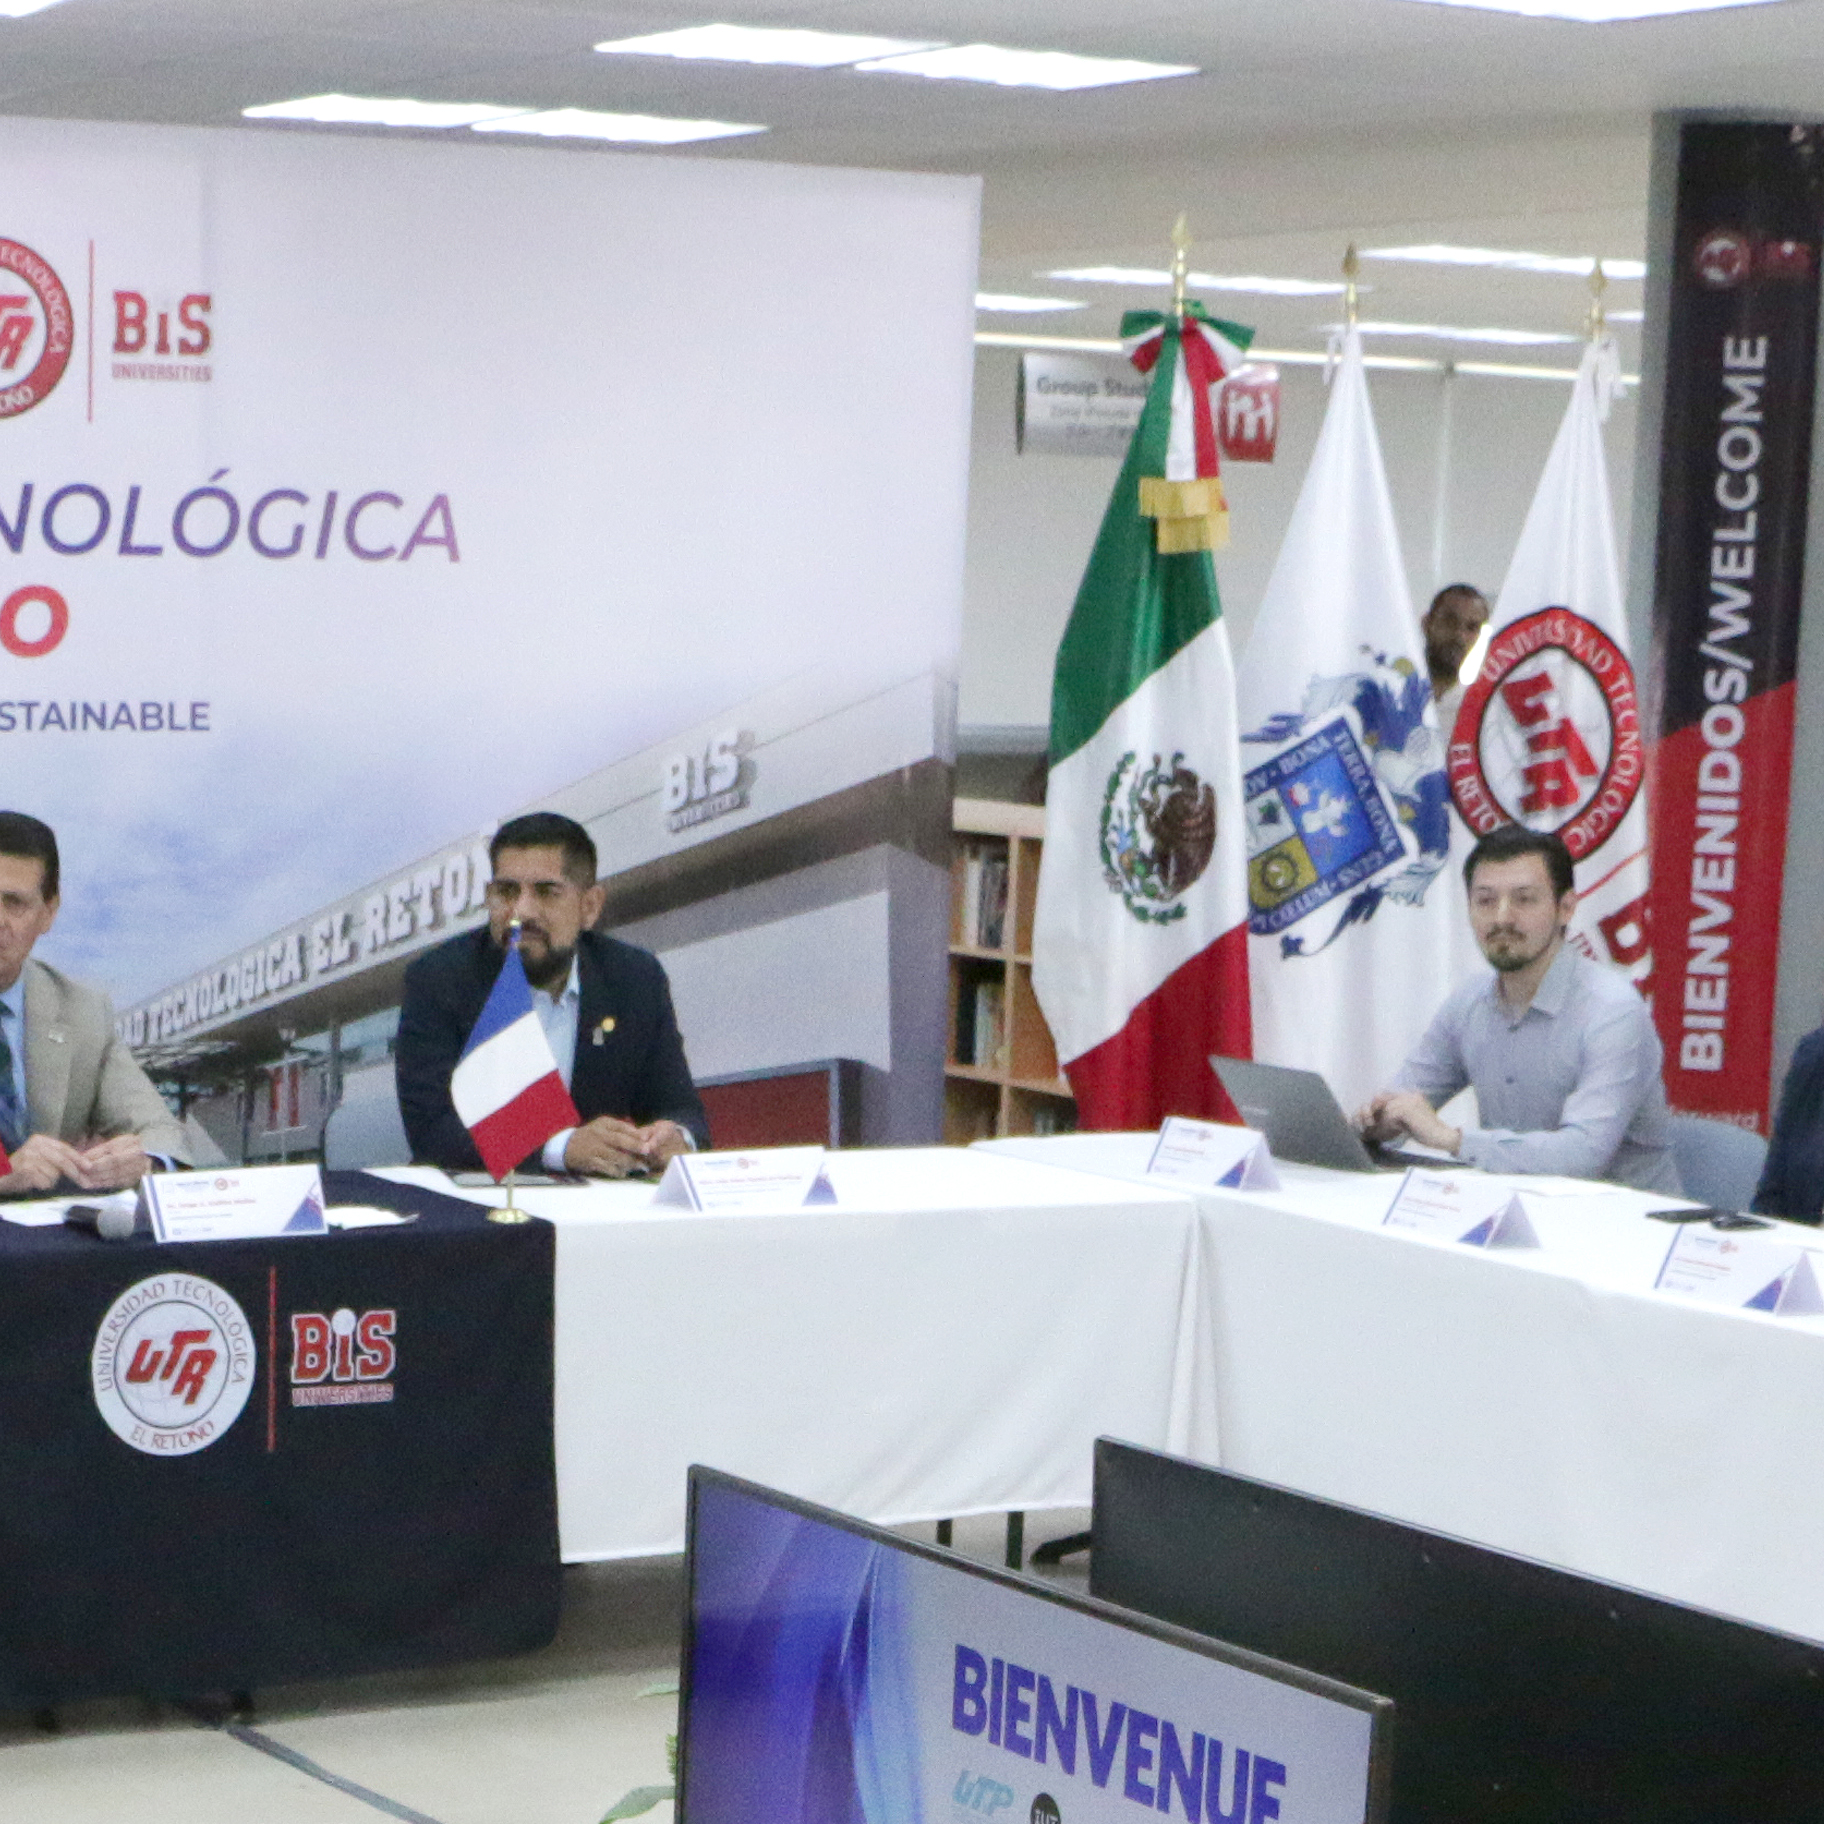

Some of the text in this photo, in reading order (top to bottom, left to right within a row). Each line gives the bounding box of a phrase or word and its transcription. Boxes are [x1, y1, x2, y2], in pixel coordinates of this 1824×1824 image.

[1680, 334, 1770, 1073] BIENVENIDOS/WELCOME
[310, 908, 352, 975] EL
[96, 1281, 165, 1393] UNIVERSIDAD
[126, 1329, 218, 1406] UTR
[291, 1308, 397, 1384] BiS
